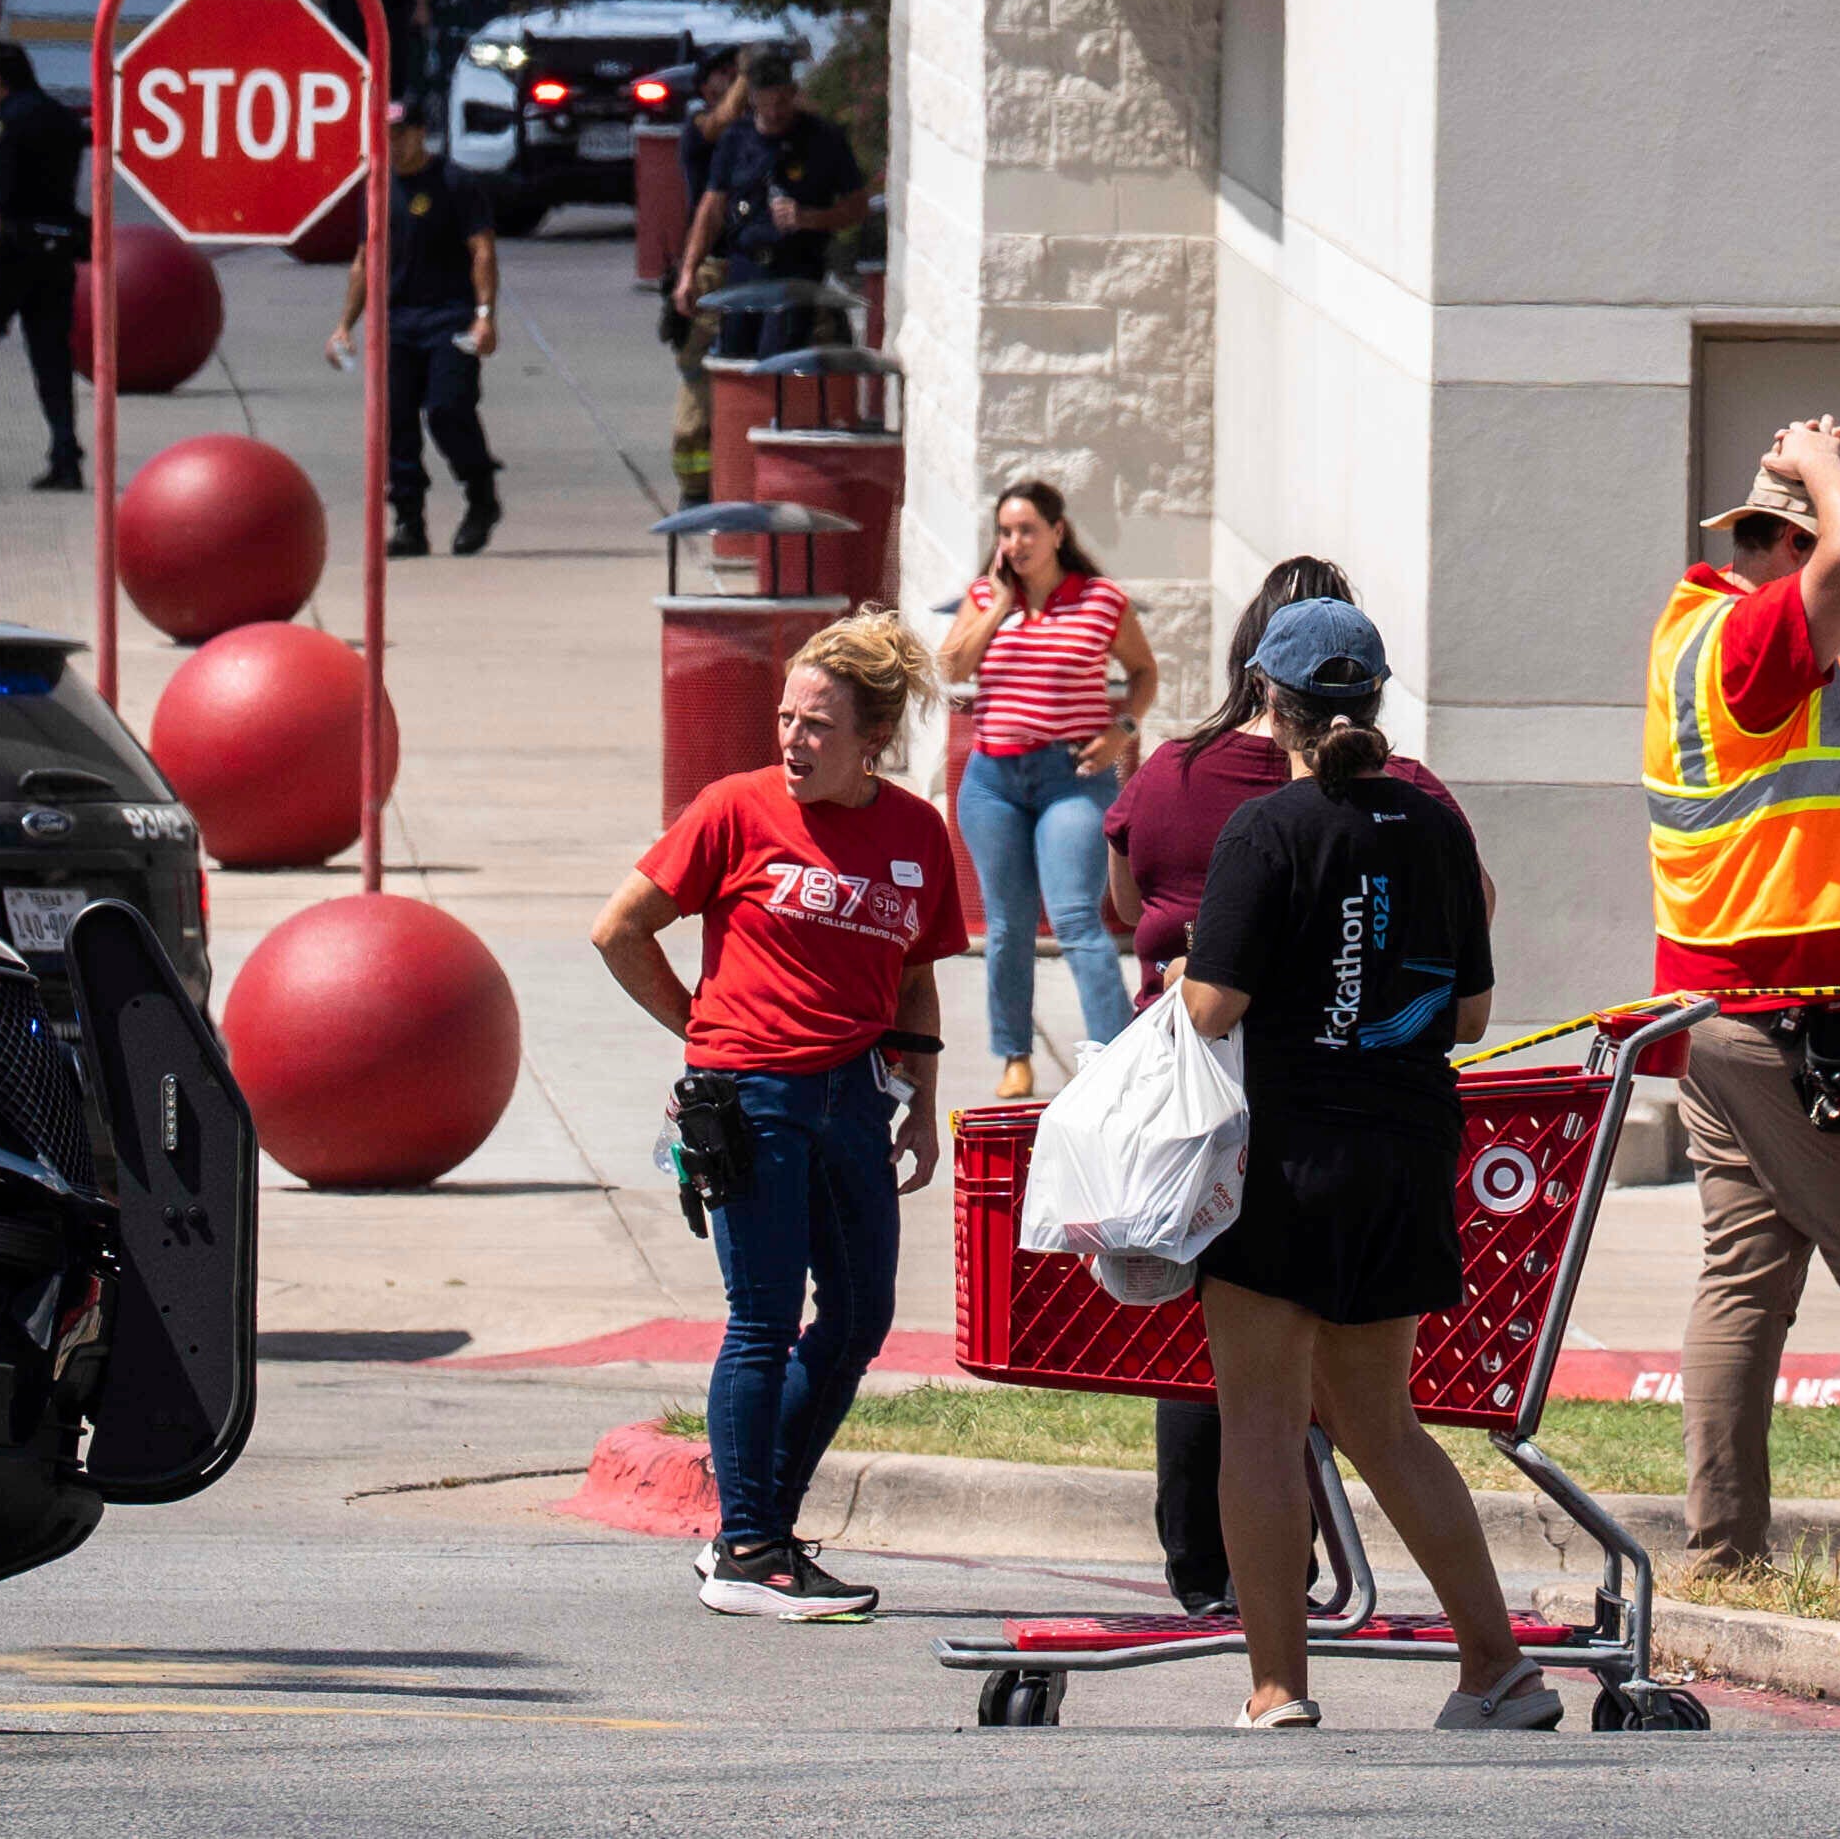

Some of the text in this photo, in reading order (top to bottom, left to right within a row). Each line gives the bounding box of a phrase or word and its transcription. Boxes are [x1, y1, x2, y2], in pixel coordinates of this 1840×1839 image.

[132, 67, 352, 161] STOP
[766, 862, 871, 918] 787
[874, 896, 900, 913] SJD
[1372, 873, 1390, 951] 2024
[817, 915, 859, 932] COLLEGE
[859, 923, 891, 940] BOUND
